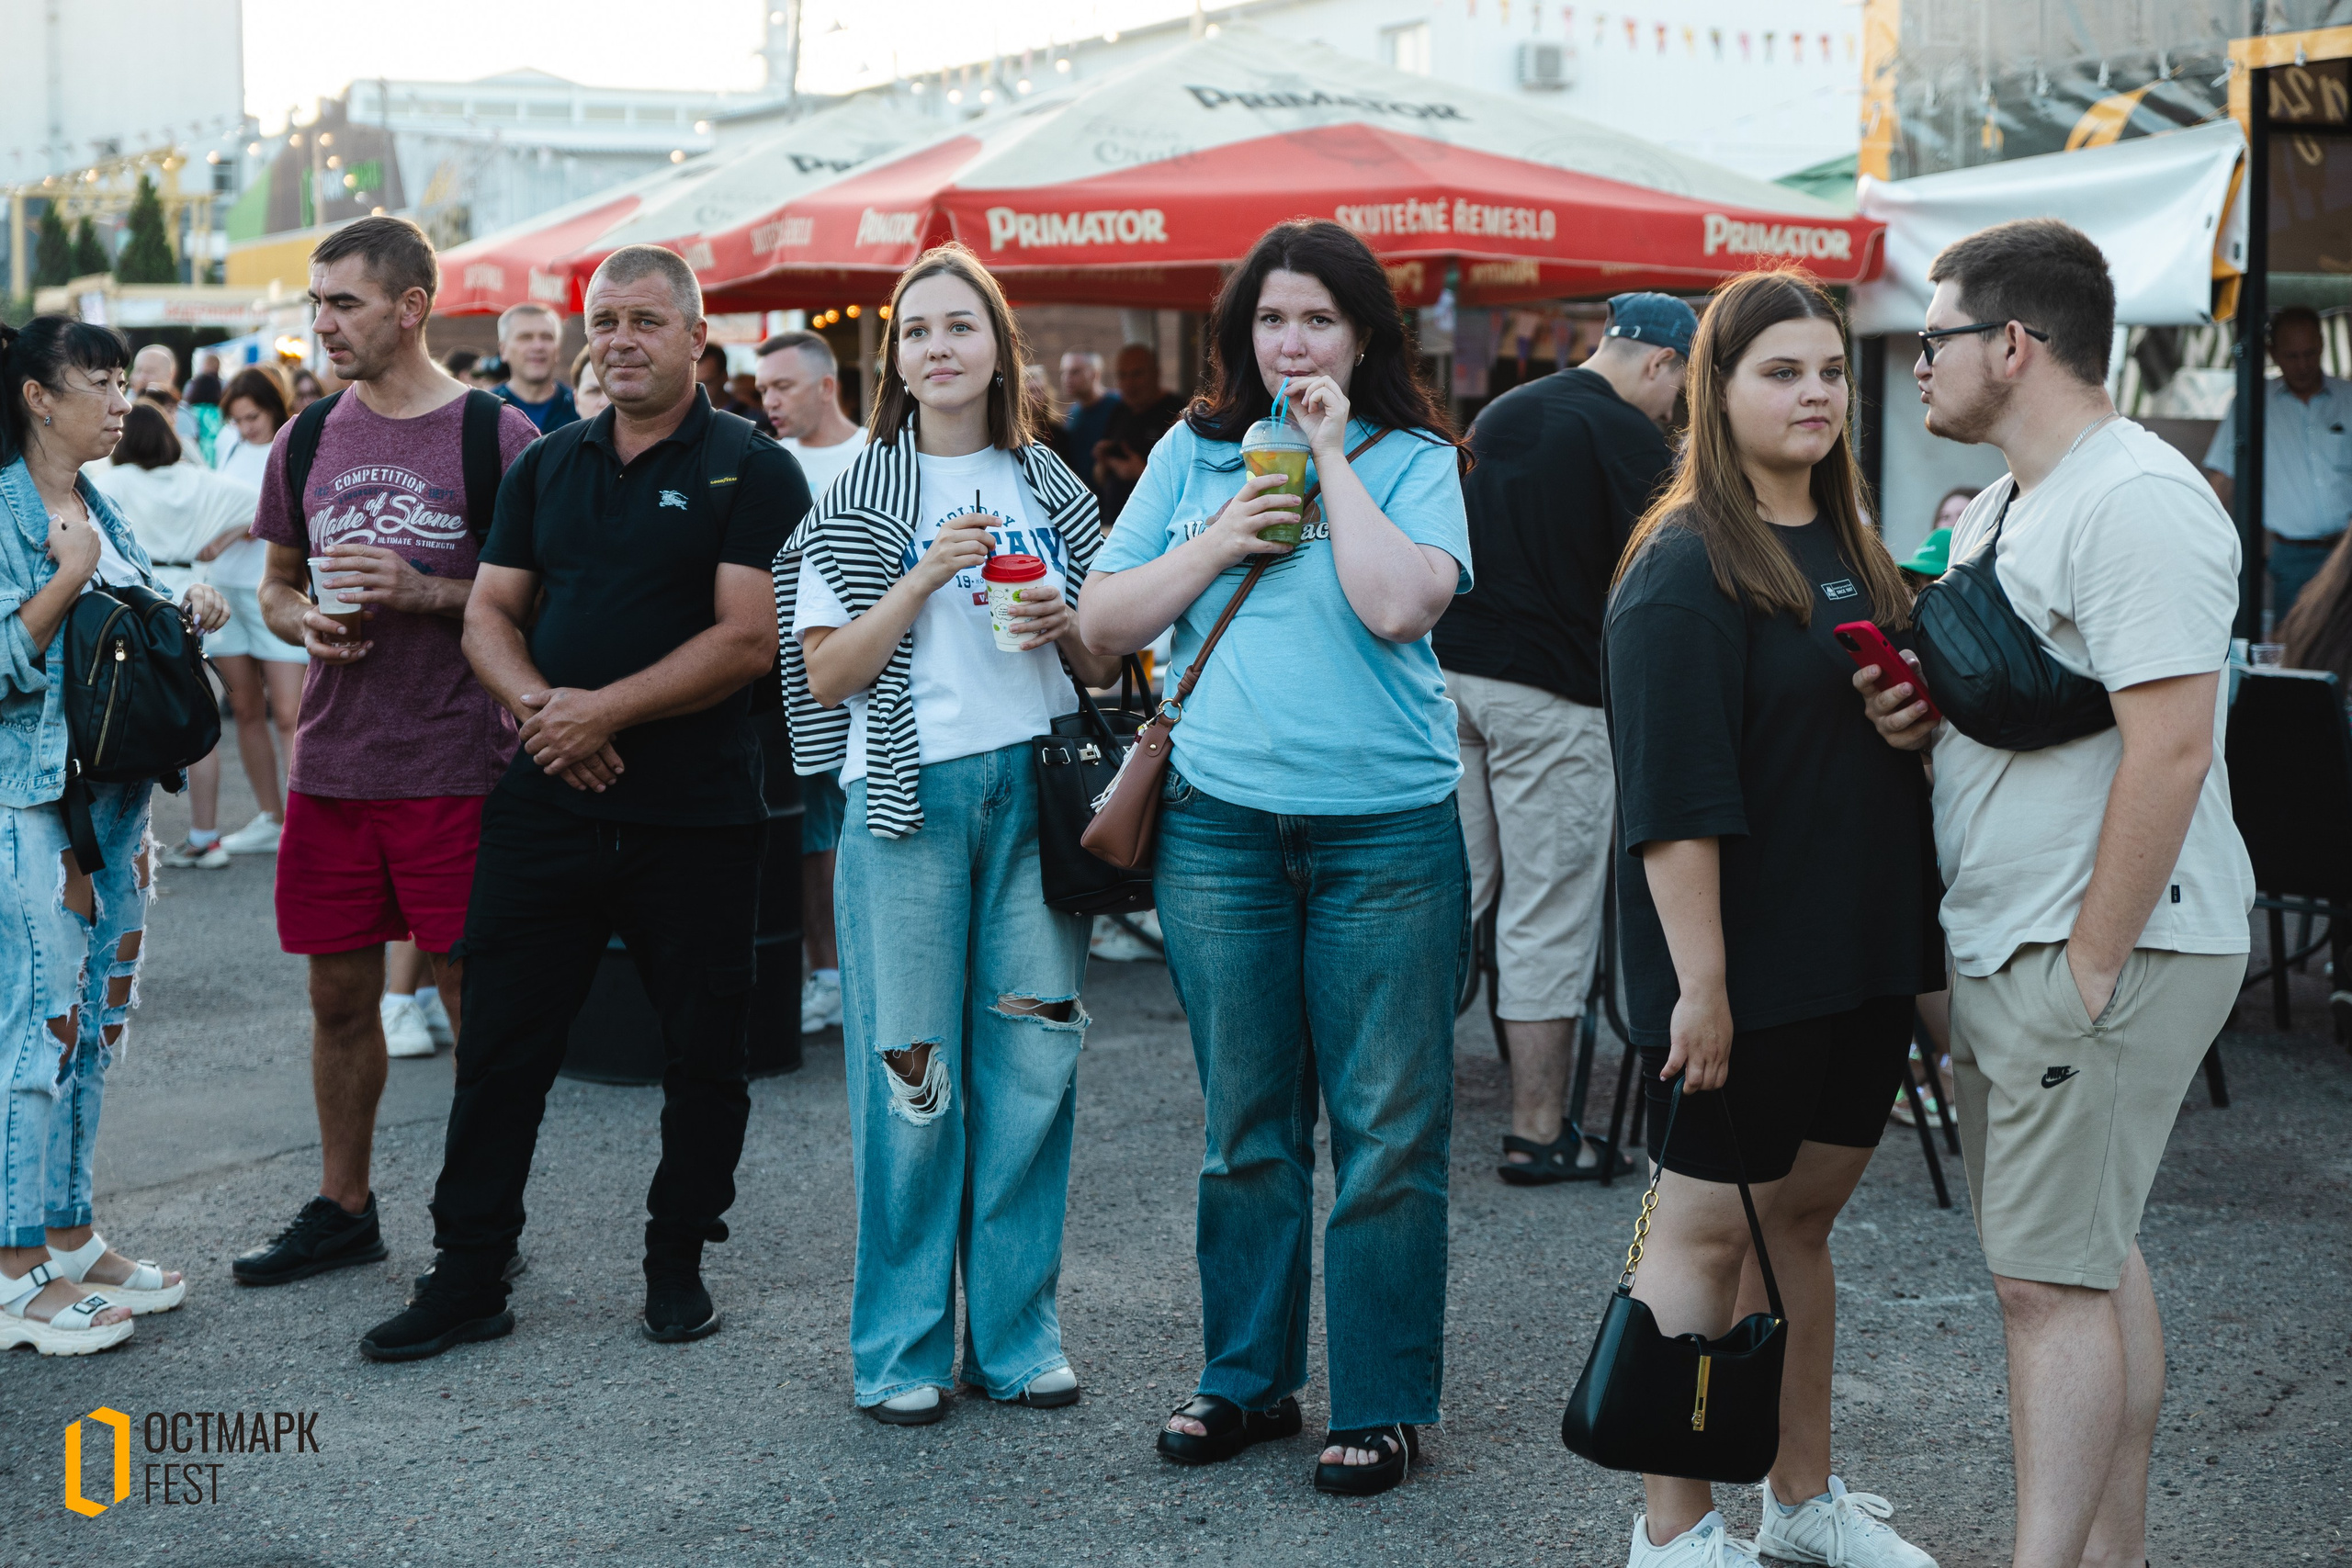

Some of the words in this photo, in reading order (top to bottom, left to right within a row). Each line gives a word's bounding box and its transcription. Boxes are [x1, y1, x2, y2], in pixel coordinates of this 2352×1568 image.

[1186, 85, 1472, 121] PRIMATOR
[986, 207, 1168, 253] PRIMATOR
[1702, 214, 1851, 260] PRIMATOR
[335, 468, 427, 494] COMPETITION
[364, 491, 388, 517] of
[374, 494, 467, 540] Stone
[309, 505, 367, 550] Made
[377, 537, 412, 547] ULTIMATE
[414, 539, 455, 550] STRENGTH
[2046, 1066, 2071, 1079] NIKE
